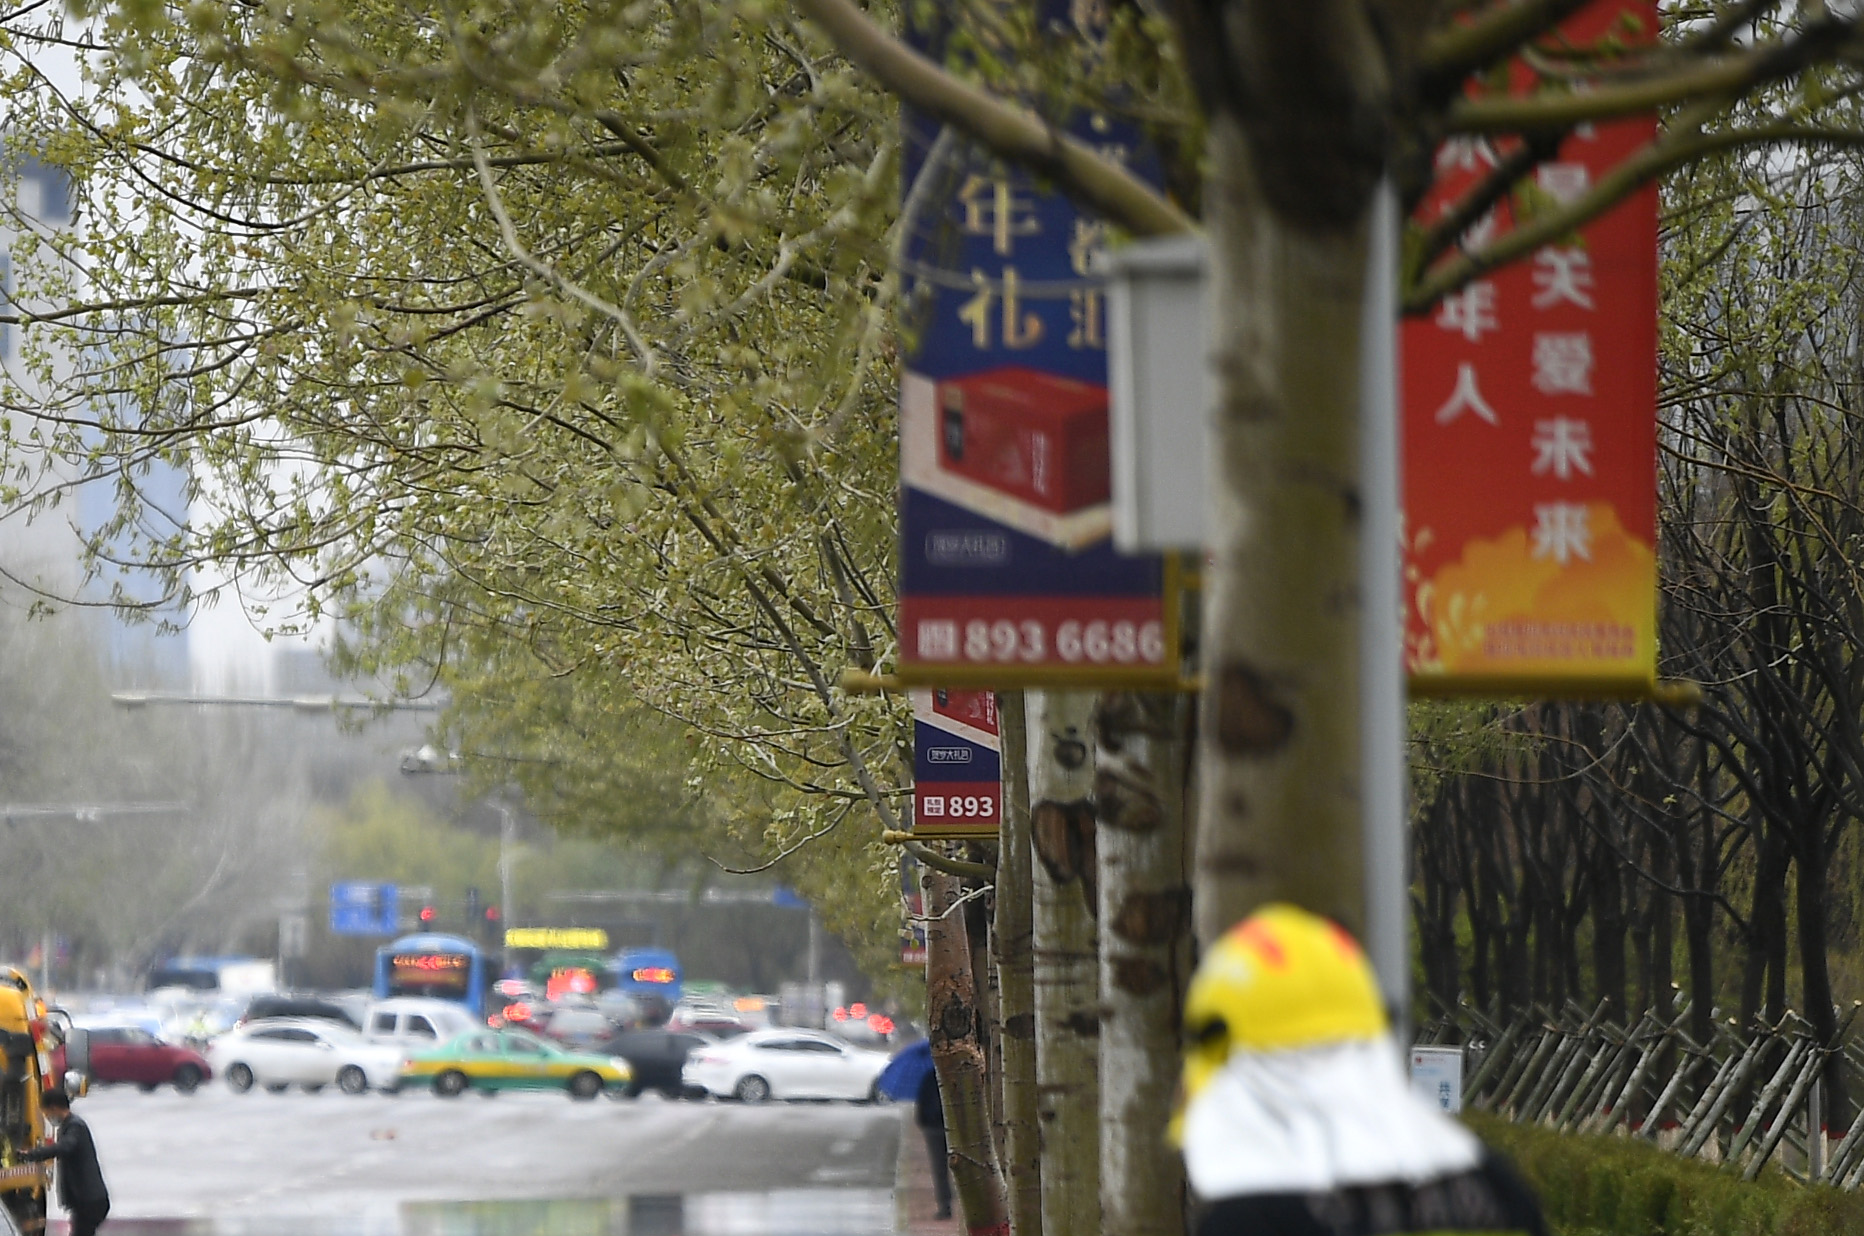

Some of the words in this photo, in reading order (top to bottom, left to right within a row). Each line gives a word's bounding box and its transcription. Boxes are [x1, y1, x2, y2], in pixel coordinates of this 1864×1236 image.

[1532, 122, 1594, 565] 关爱未来
[964, 618, 1045, 664] 893
[1055, 618, 1165, 664] 6686
[949, 796, 994, 817] 893
